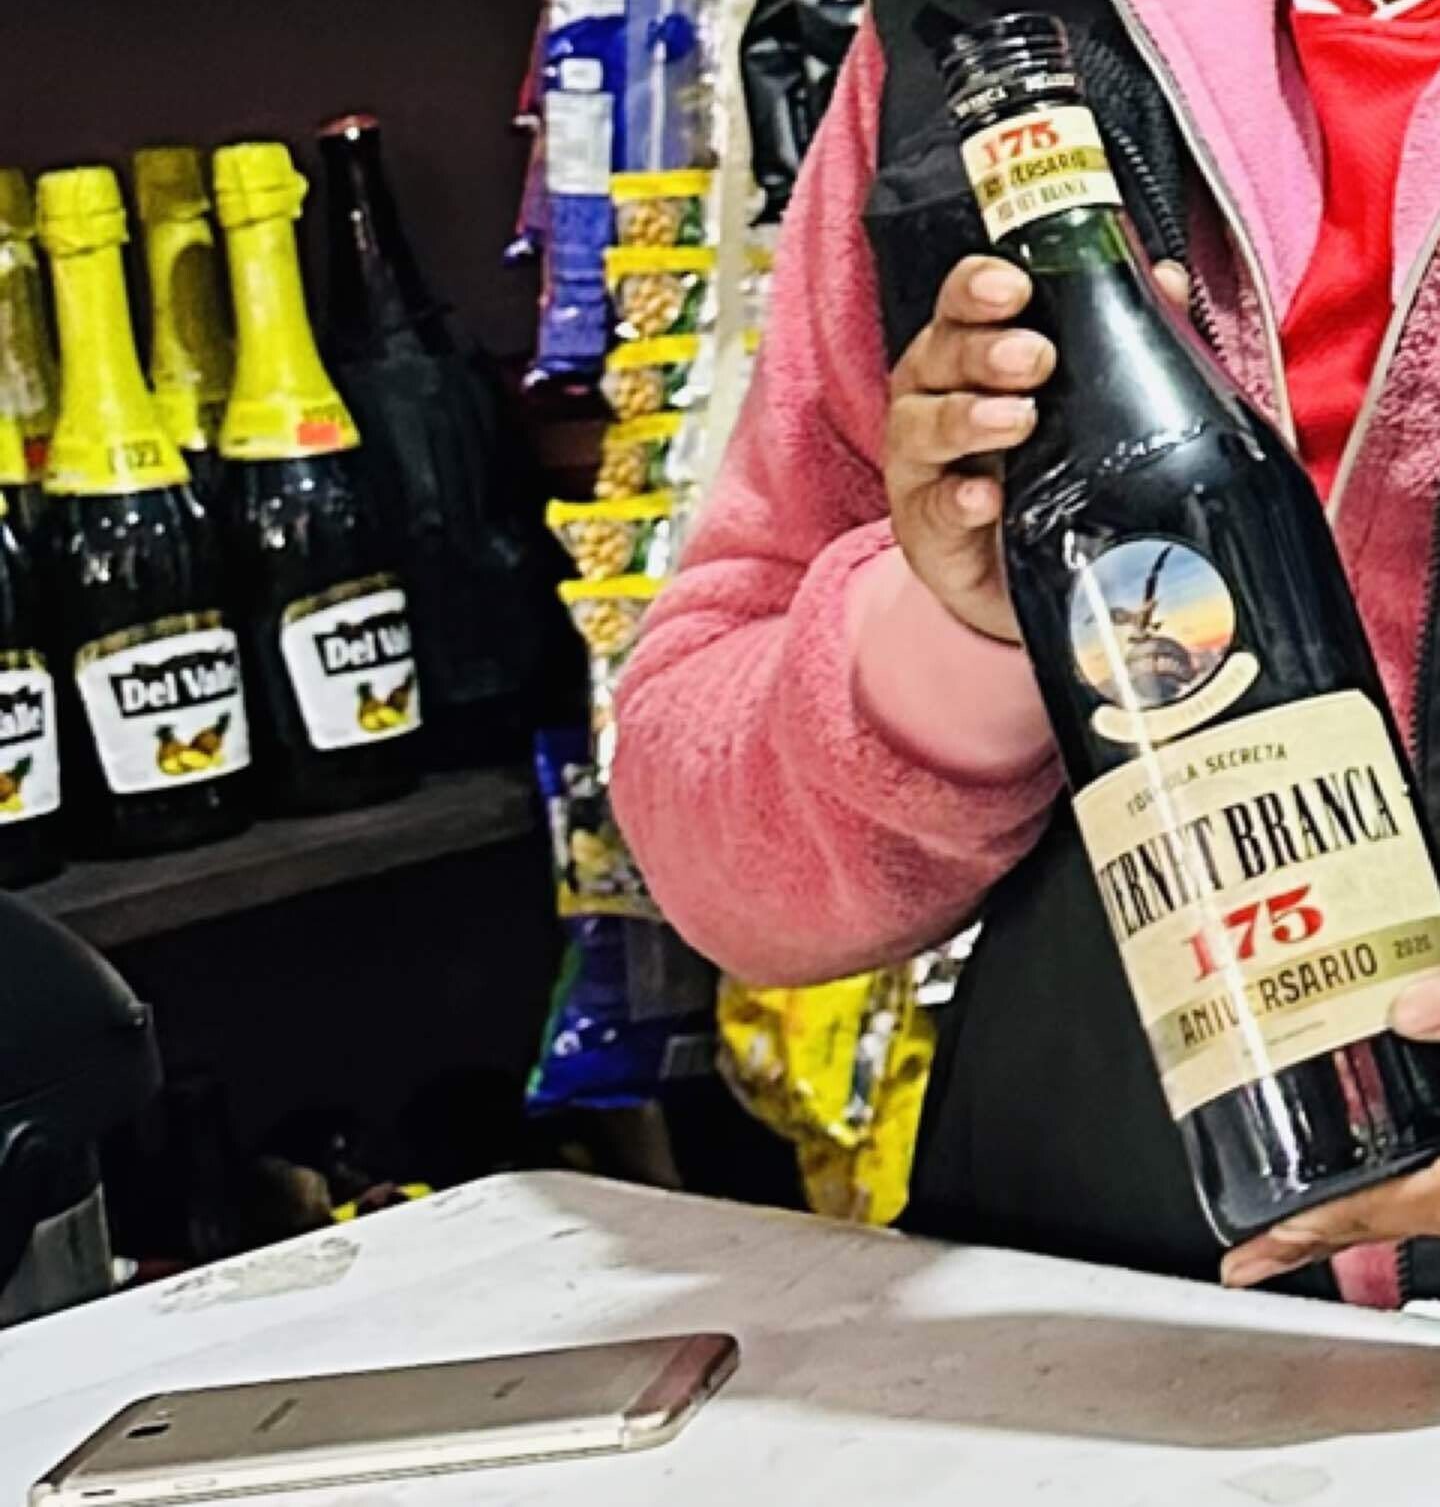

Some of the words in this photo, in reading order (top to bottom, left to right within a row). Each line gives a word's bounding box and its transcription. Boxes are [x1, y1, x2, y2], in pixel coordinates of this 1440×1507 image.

[981, 118, 1061, 166] 175
[324, 631, 377, 671] Del
[121, 669, 178, 715] Del
[1205, 741, 1288, 776] SECRETA
[1224, 763, 1401, 882] BRANCA
[1183, 884, 1326, 982] 175
